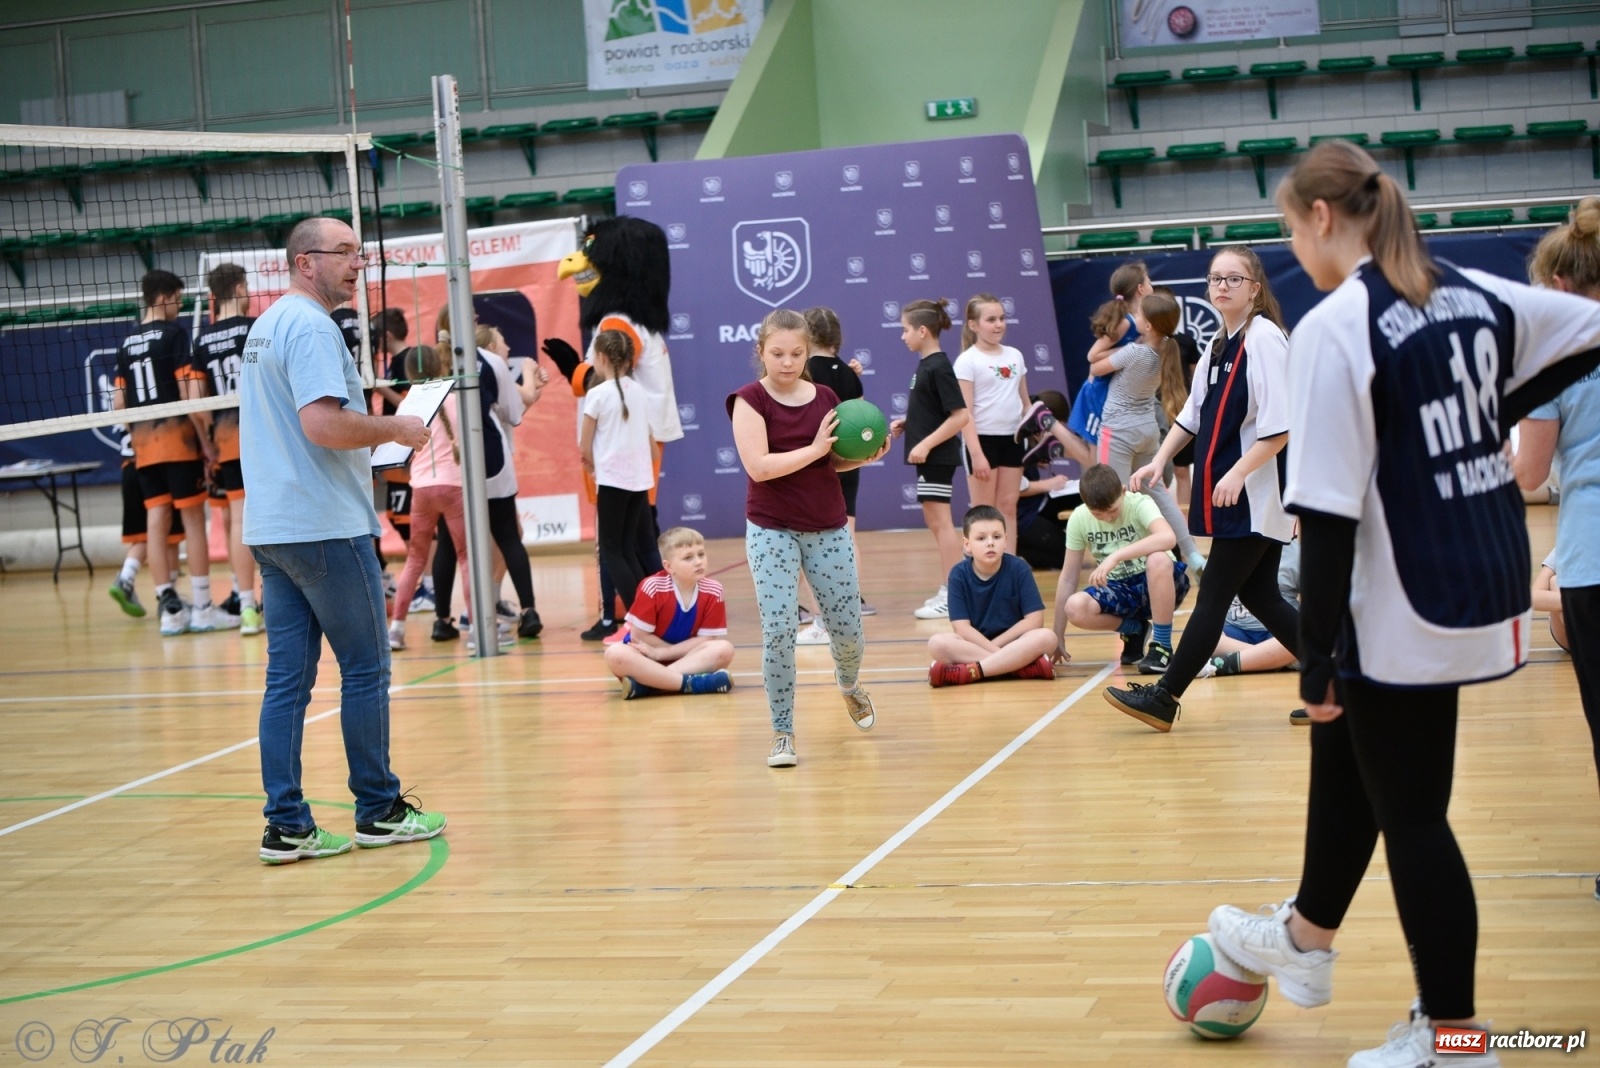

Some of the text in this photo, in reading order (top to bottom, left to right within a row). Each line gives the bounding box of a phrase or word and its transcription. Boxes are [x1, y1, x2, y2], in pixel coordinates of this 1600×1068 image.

[605, 33, 751, 64] powiat raciborski
[469, 234, 521, 256] GLEM!
[1224, 361, 1233, 373] 18
[129, 357, 158, 403] 11
[1419, 327, 1500, 457] nr 18
[536, 522, 567, 539] JSW
[1087, 524, 1136, 543] BATMAN
